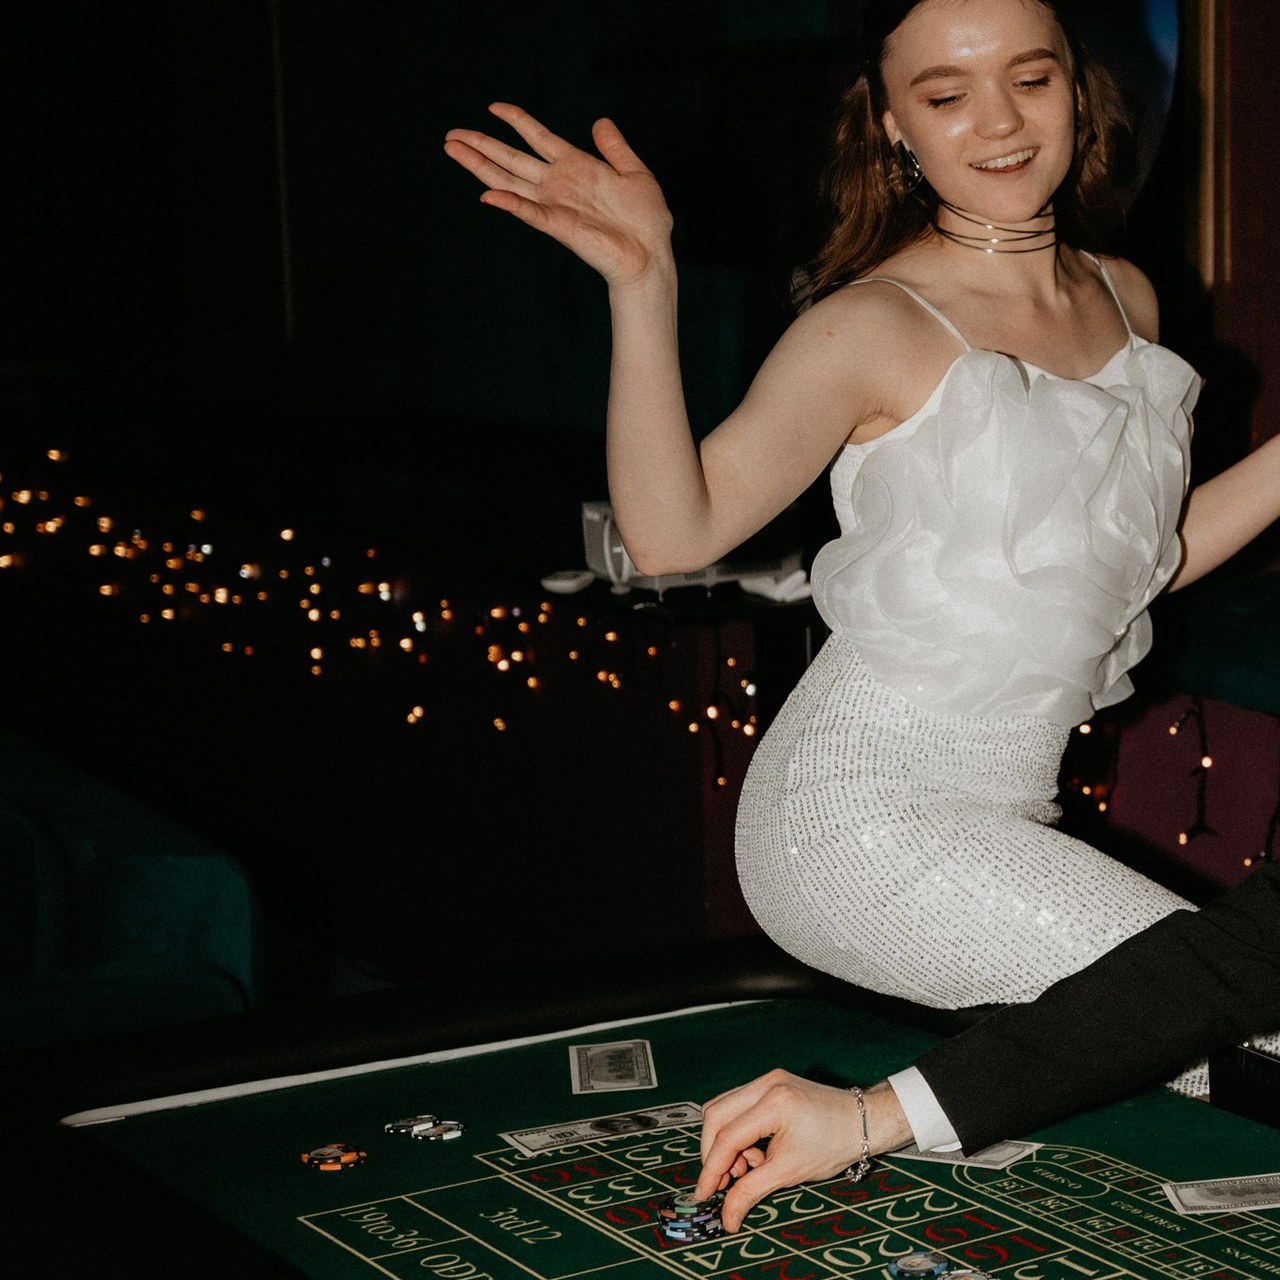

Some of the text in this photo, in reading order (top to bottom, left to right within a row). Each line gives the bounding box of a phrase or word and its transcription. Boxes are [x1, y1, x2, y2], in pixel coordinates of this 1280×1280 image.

[528, 1158, 617, 1184] 36
[567, 1176, 653, 1205] 33
[829, 1172, 913, 1203] 25
[866, 1191, 959, 1222] 22
[780, 1214, 867, 1246] 23
[924, 1213, 1001, 1243] 19
[682, 1235, 776, 1270] 24
[822, 1234, 915, 1268] 20
[963, 1234, 1048, 1266] 16
